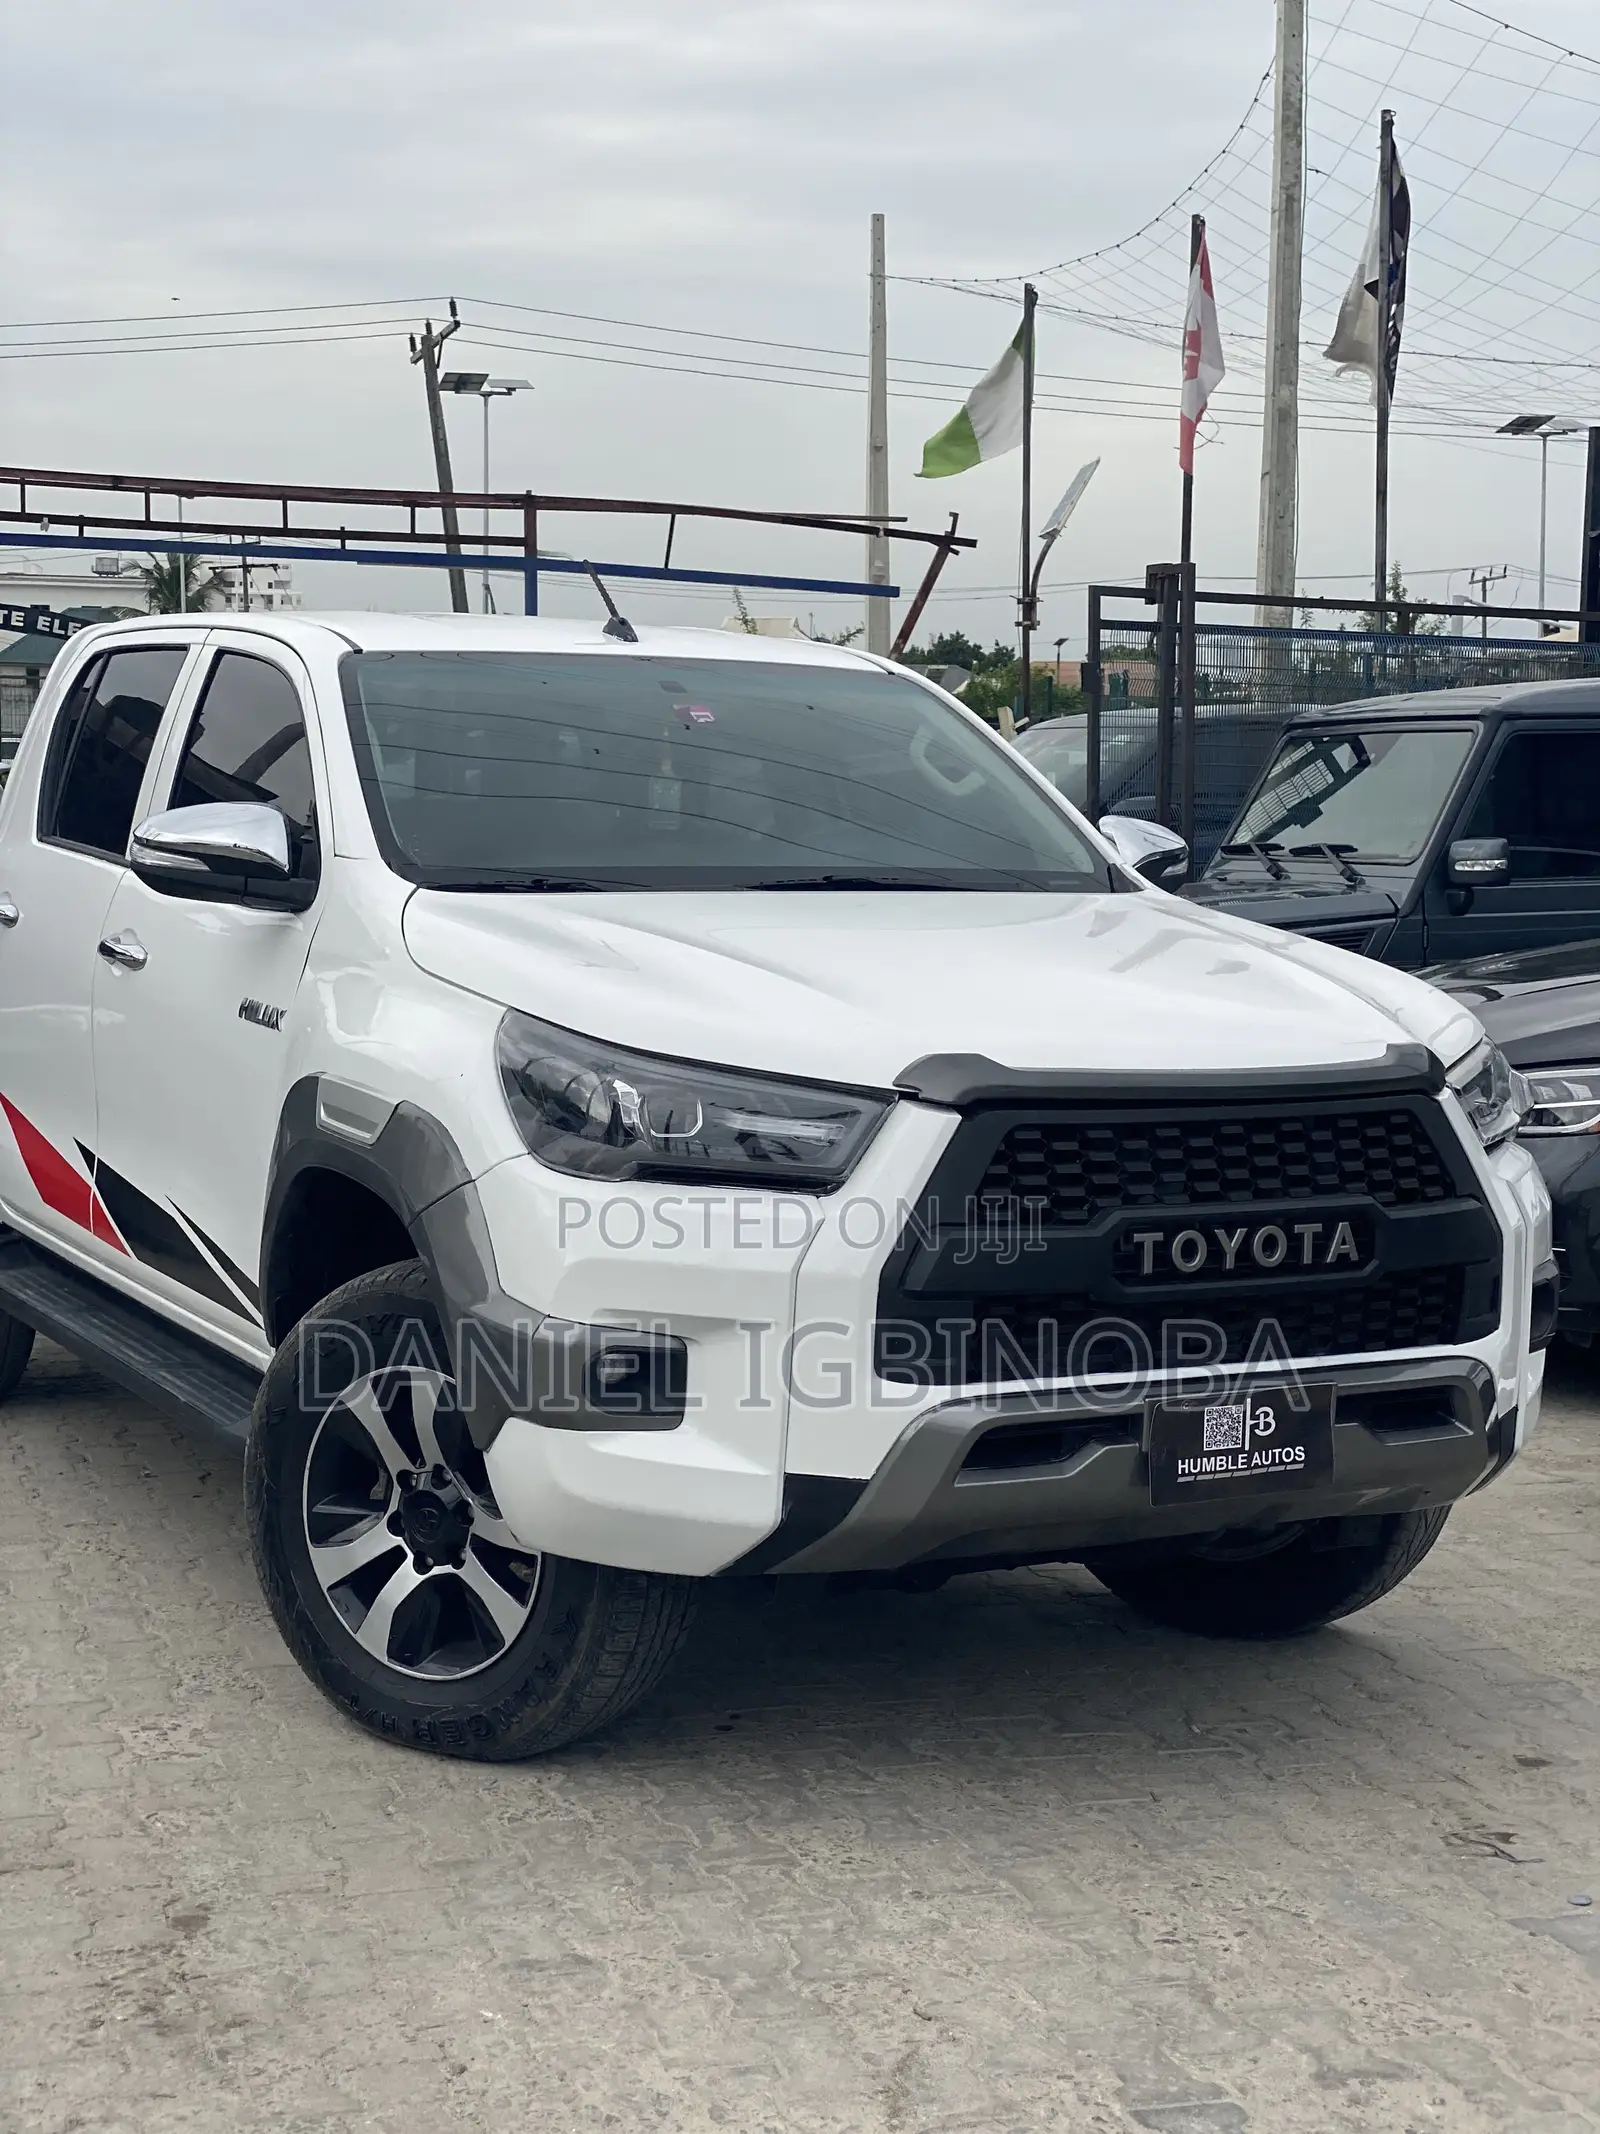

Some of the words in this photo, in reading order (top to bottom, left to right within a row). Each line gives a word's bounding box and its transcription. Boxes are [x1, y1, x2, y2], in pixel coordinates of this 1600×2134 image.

[238, 997, 287, 1033] HILUX
[1133, 1219, 1360, 1277] TOYOTA
[1177, 1453, 1248, 1475] HUMBLE
[1251, 1445, 1306, 1467] AUTOS
